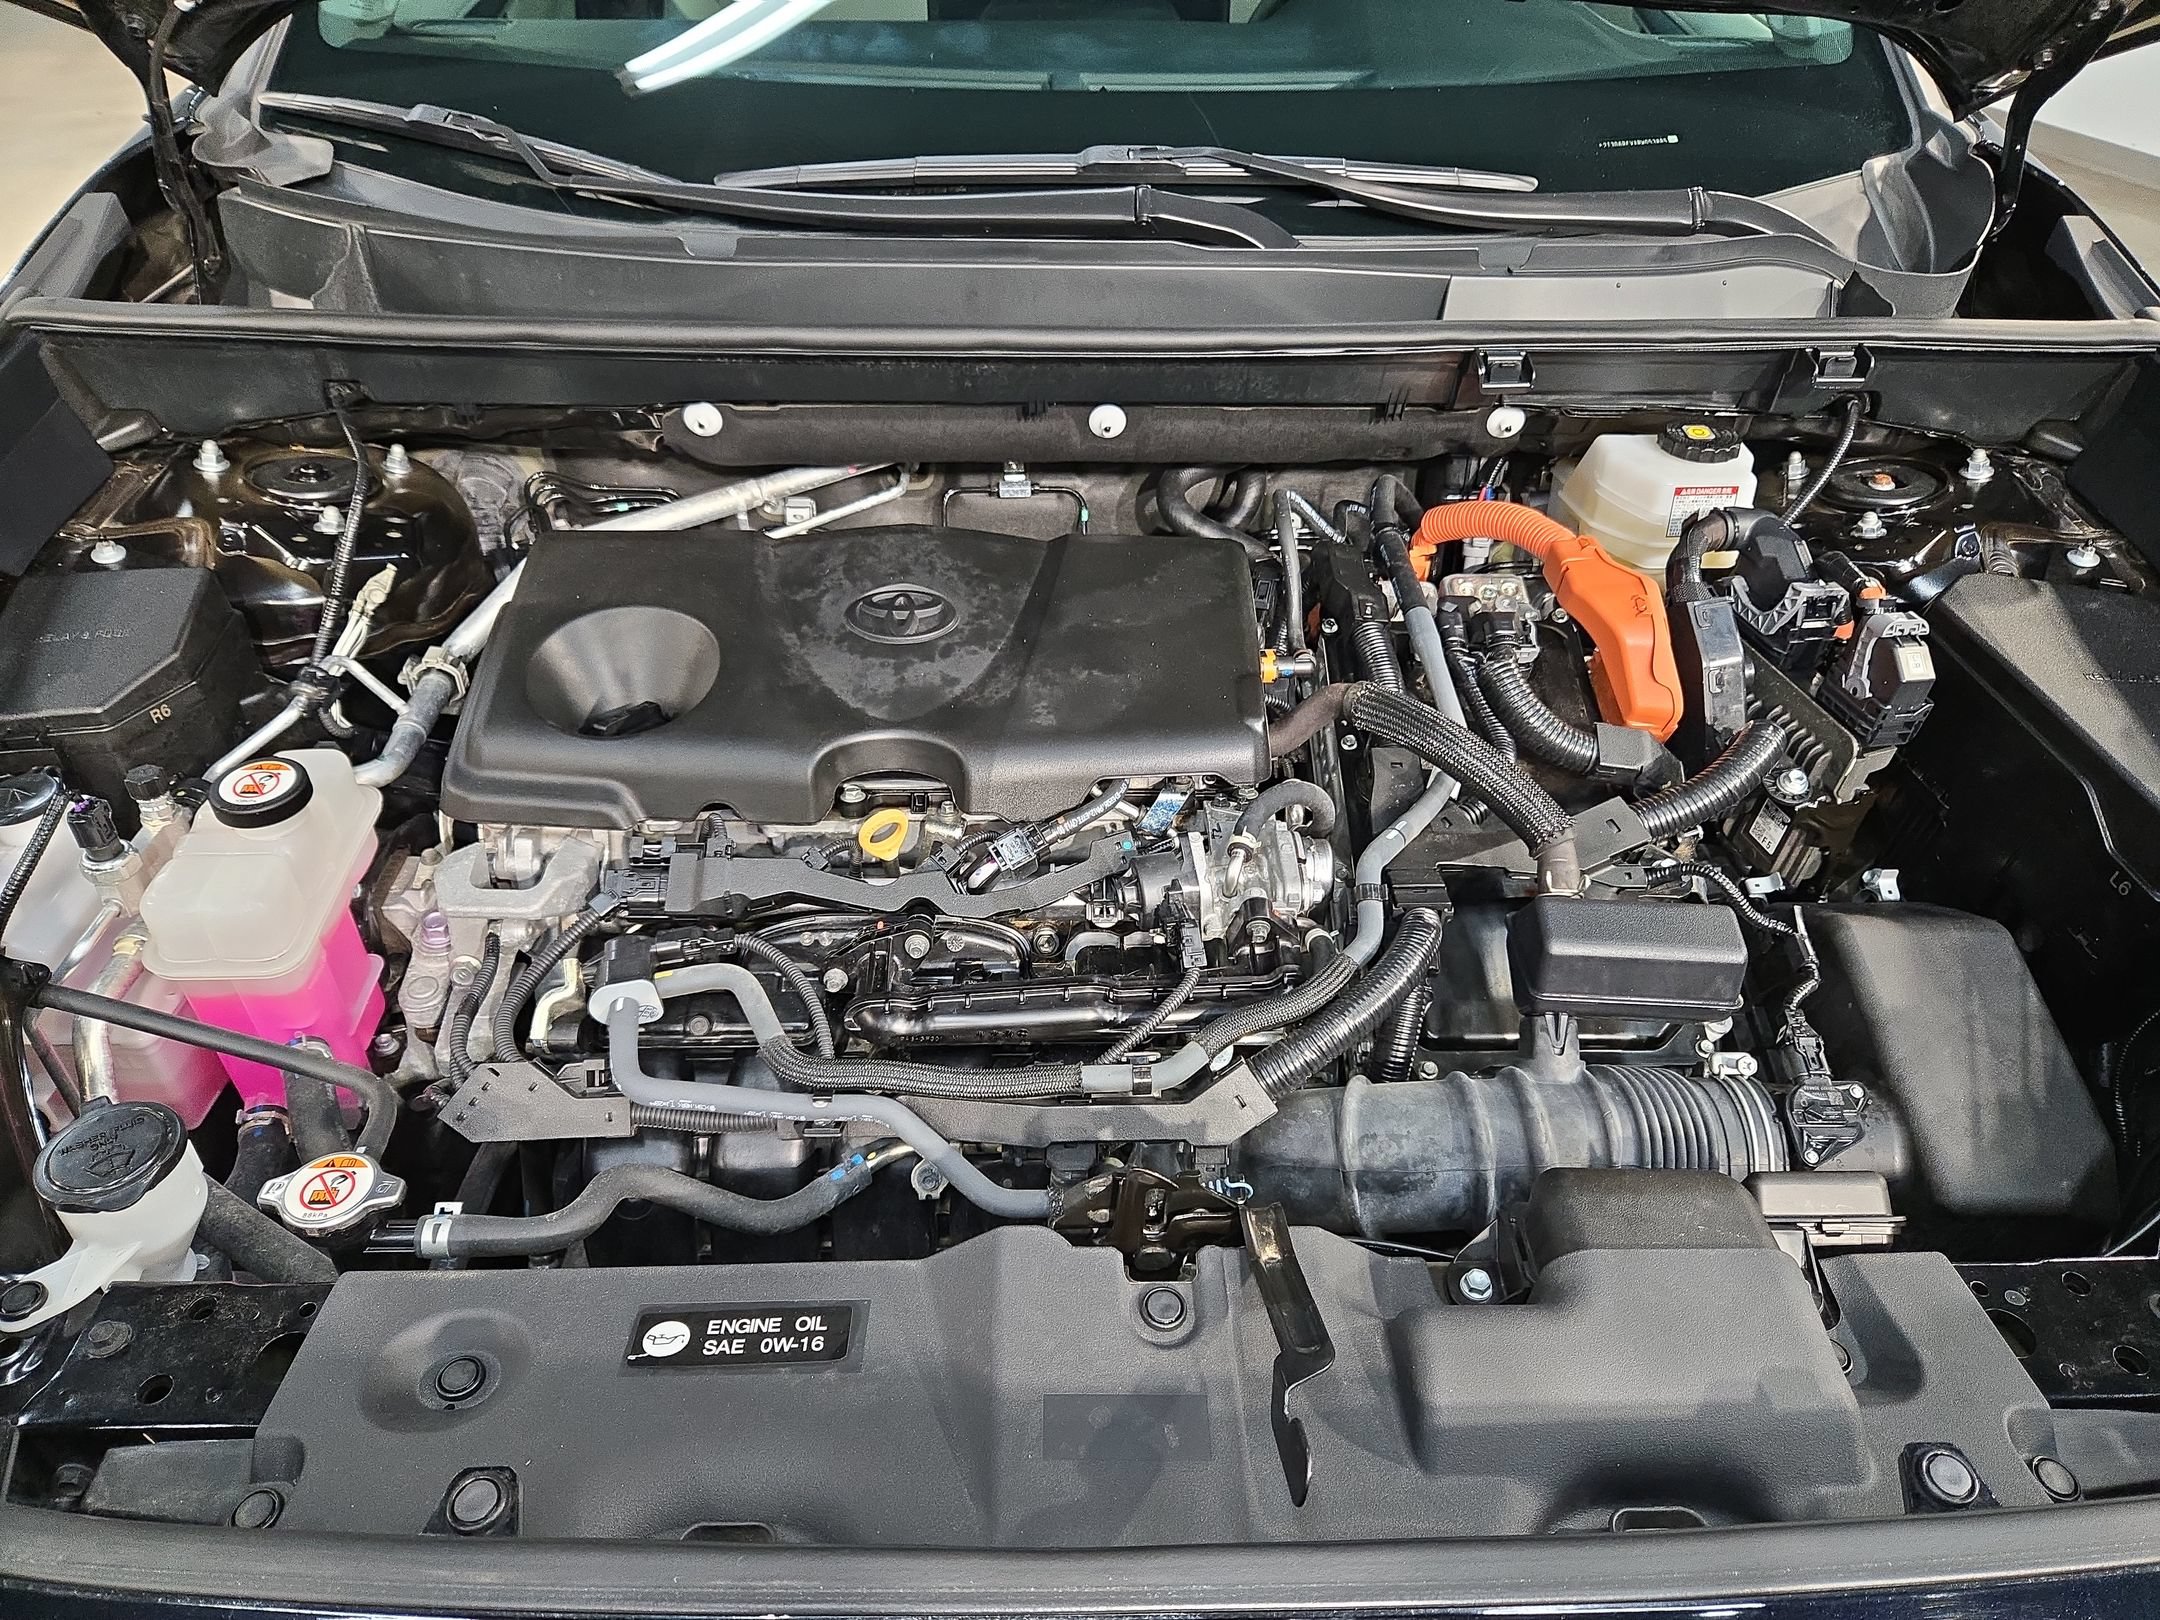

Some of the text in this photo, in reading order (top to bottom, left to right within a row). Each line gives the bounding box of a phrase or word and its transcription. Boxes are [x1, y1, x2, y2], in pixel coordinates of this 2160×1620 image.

[149, 703, 172, 724] R6
[2109, 870, 2132, 896] L6
[706, 1315, 828, 1335] ENGINE OIL
[702, 1336, 825, 1356] SAE 0W-16
